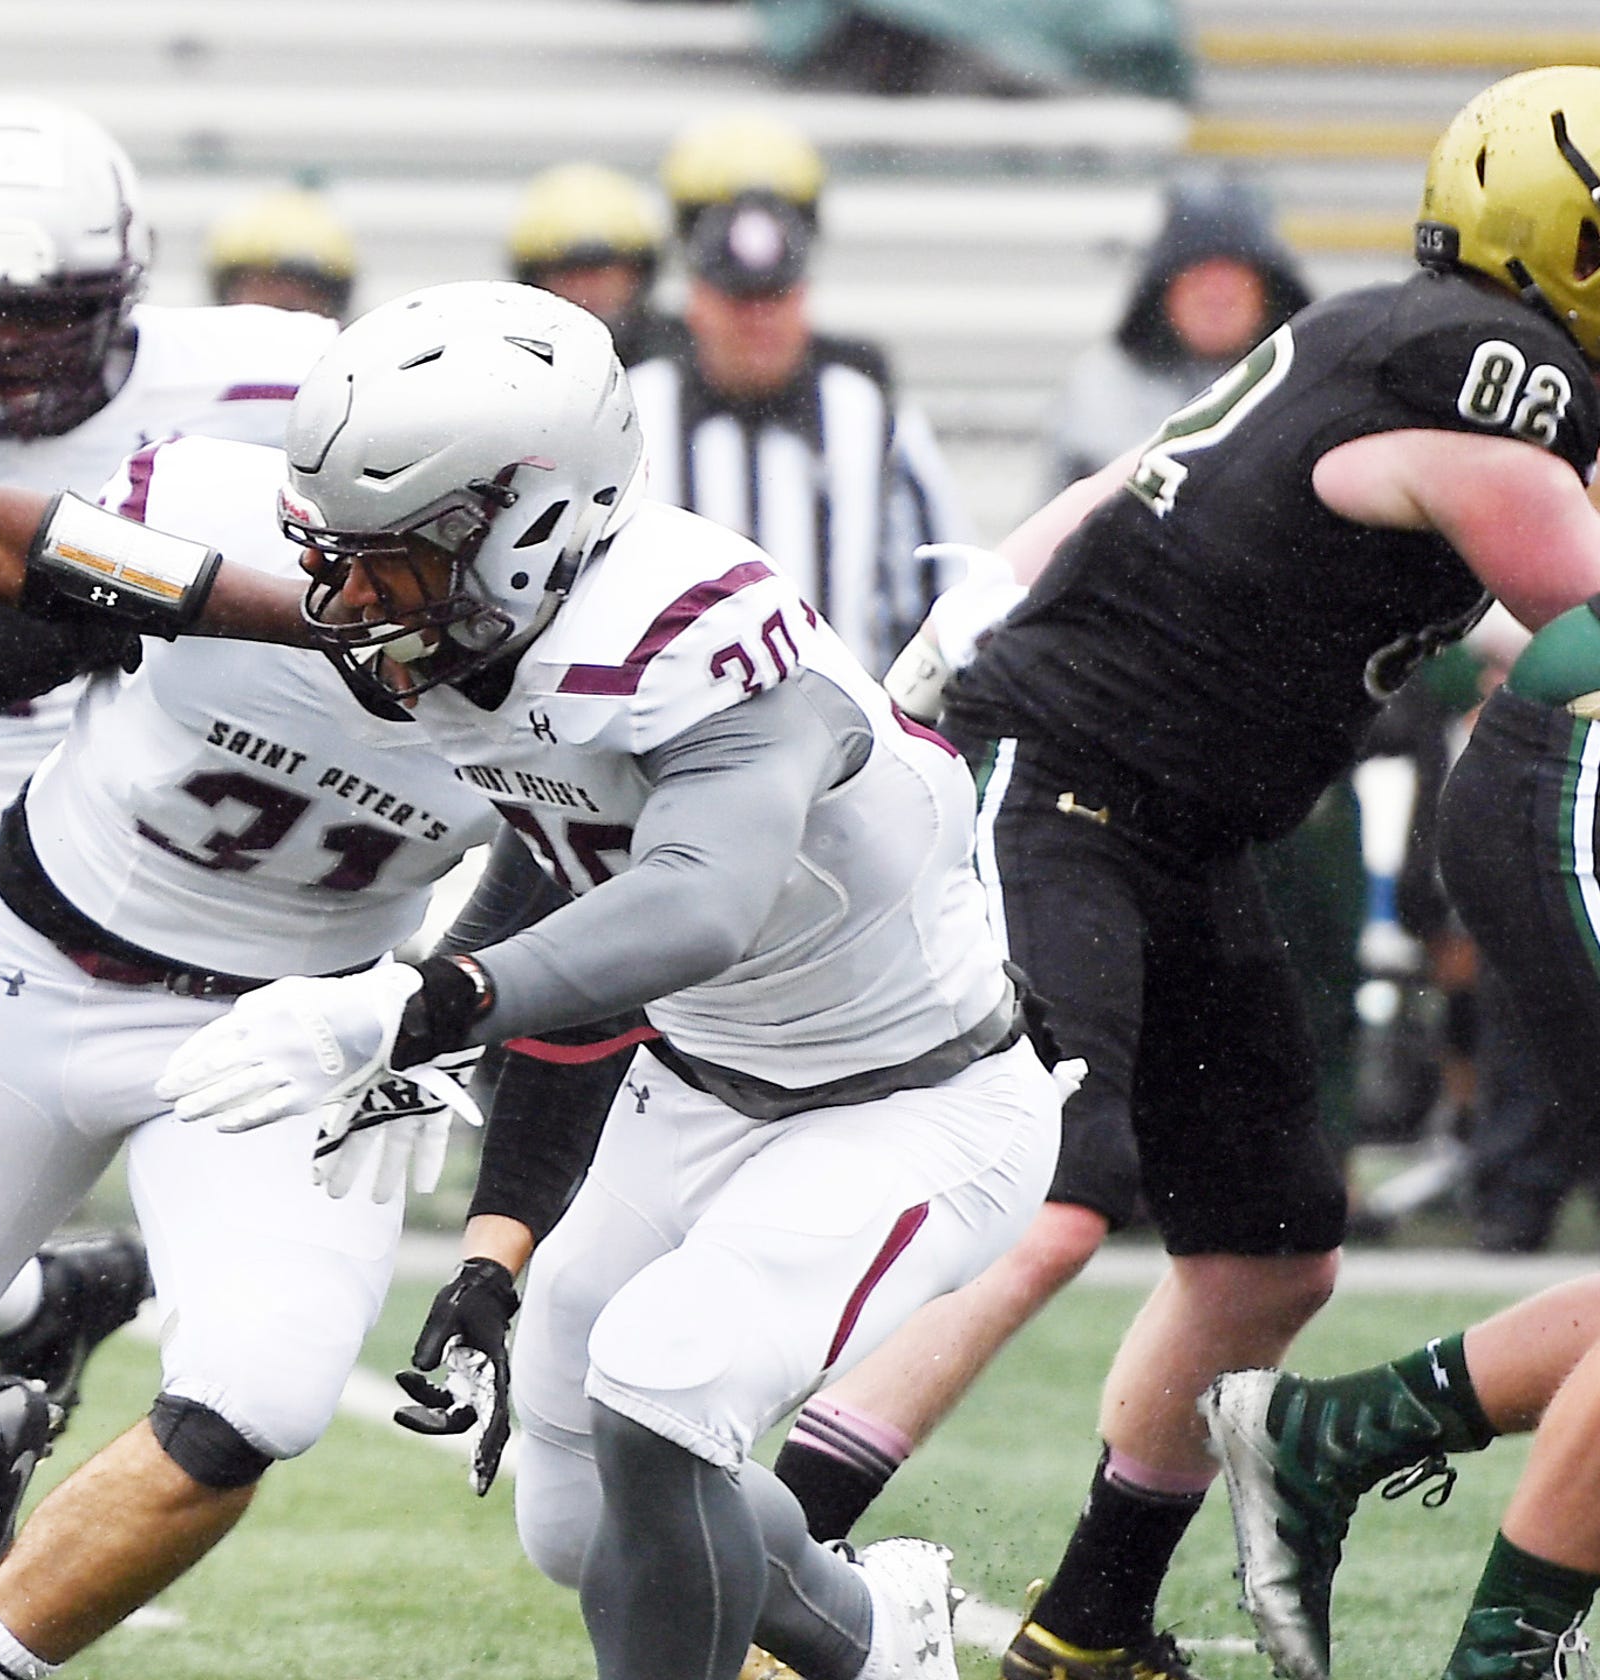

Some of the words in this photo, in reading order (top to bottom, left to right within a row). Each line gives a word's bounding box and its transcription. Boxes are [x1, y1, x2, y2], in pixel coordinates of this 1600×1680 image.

[1457, 340, 1572, 444] 82
[710, 608, 799, 692] 30
[135, 769, 408, 892] 31
[206, 721, 308, 775] SAINT
[317, 767, 449, 841] PETER'S
[513, 770, 599, 813] PETER'S
